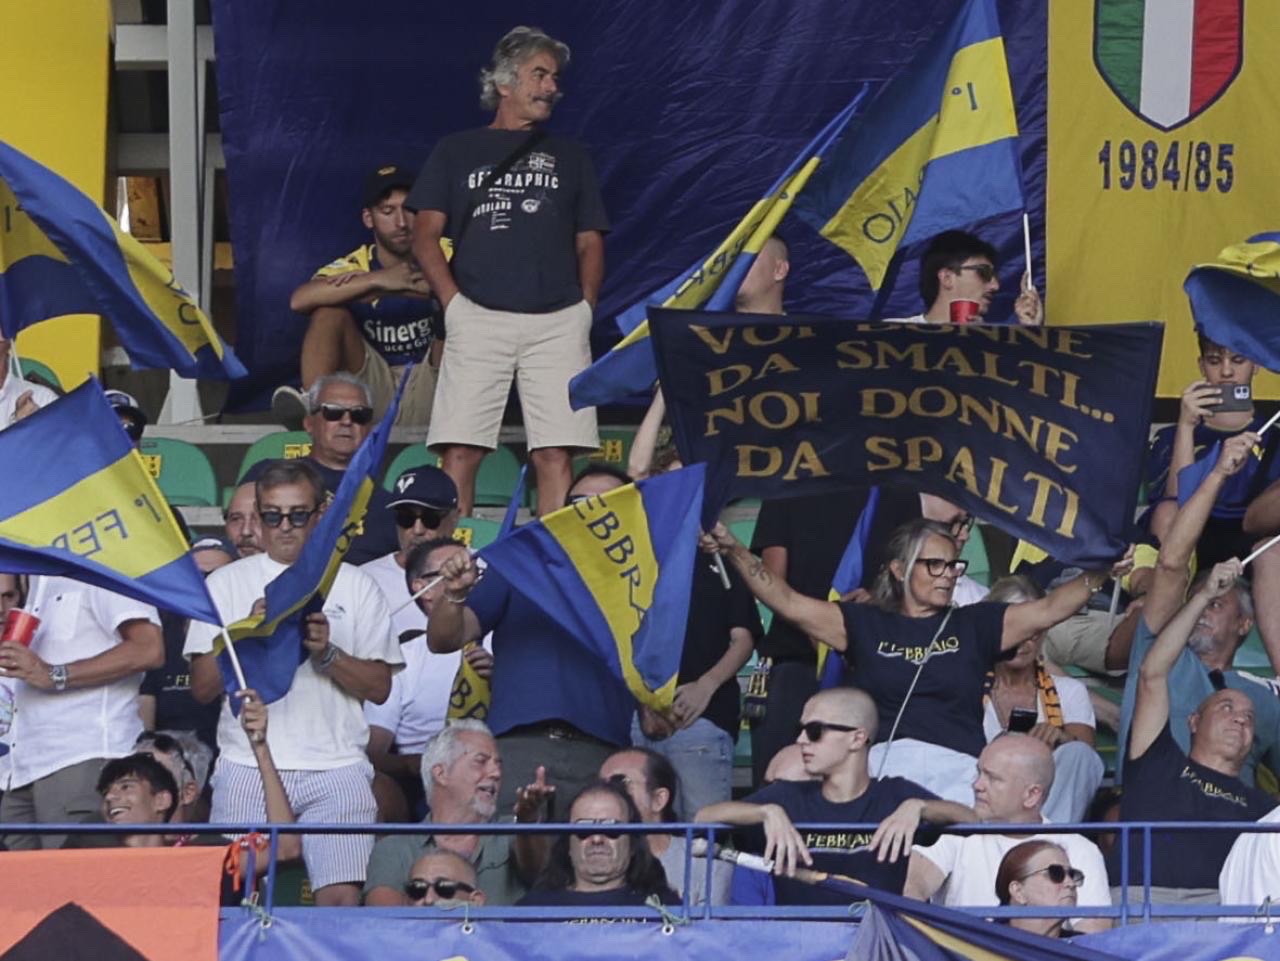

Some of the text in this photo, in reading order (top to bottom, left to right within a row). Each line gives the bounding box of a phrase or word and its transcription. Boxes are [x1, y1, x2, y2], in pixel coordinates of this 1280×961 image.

[1098, 140, 1235, 193] 1984/85
[705, 353, 801, 396] DA
[704, 387, 1080, 475] NOI DONNE
[735, 436, 1081, 539] DA SPALTI
